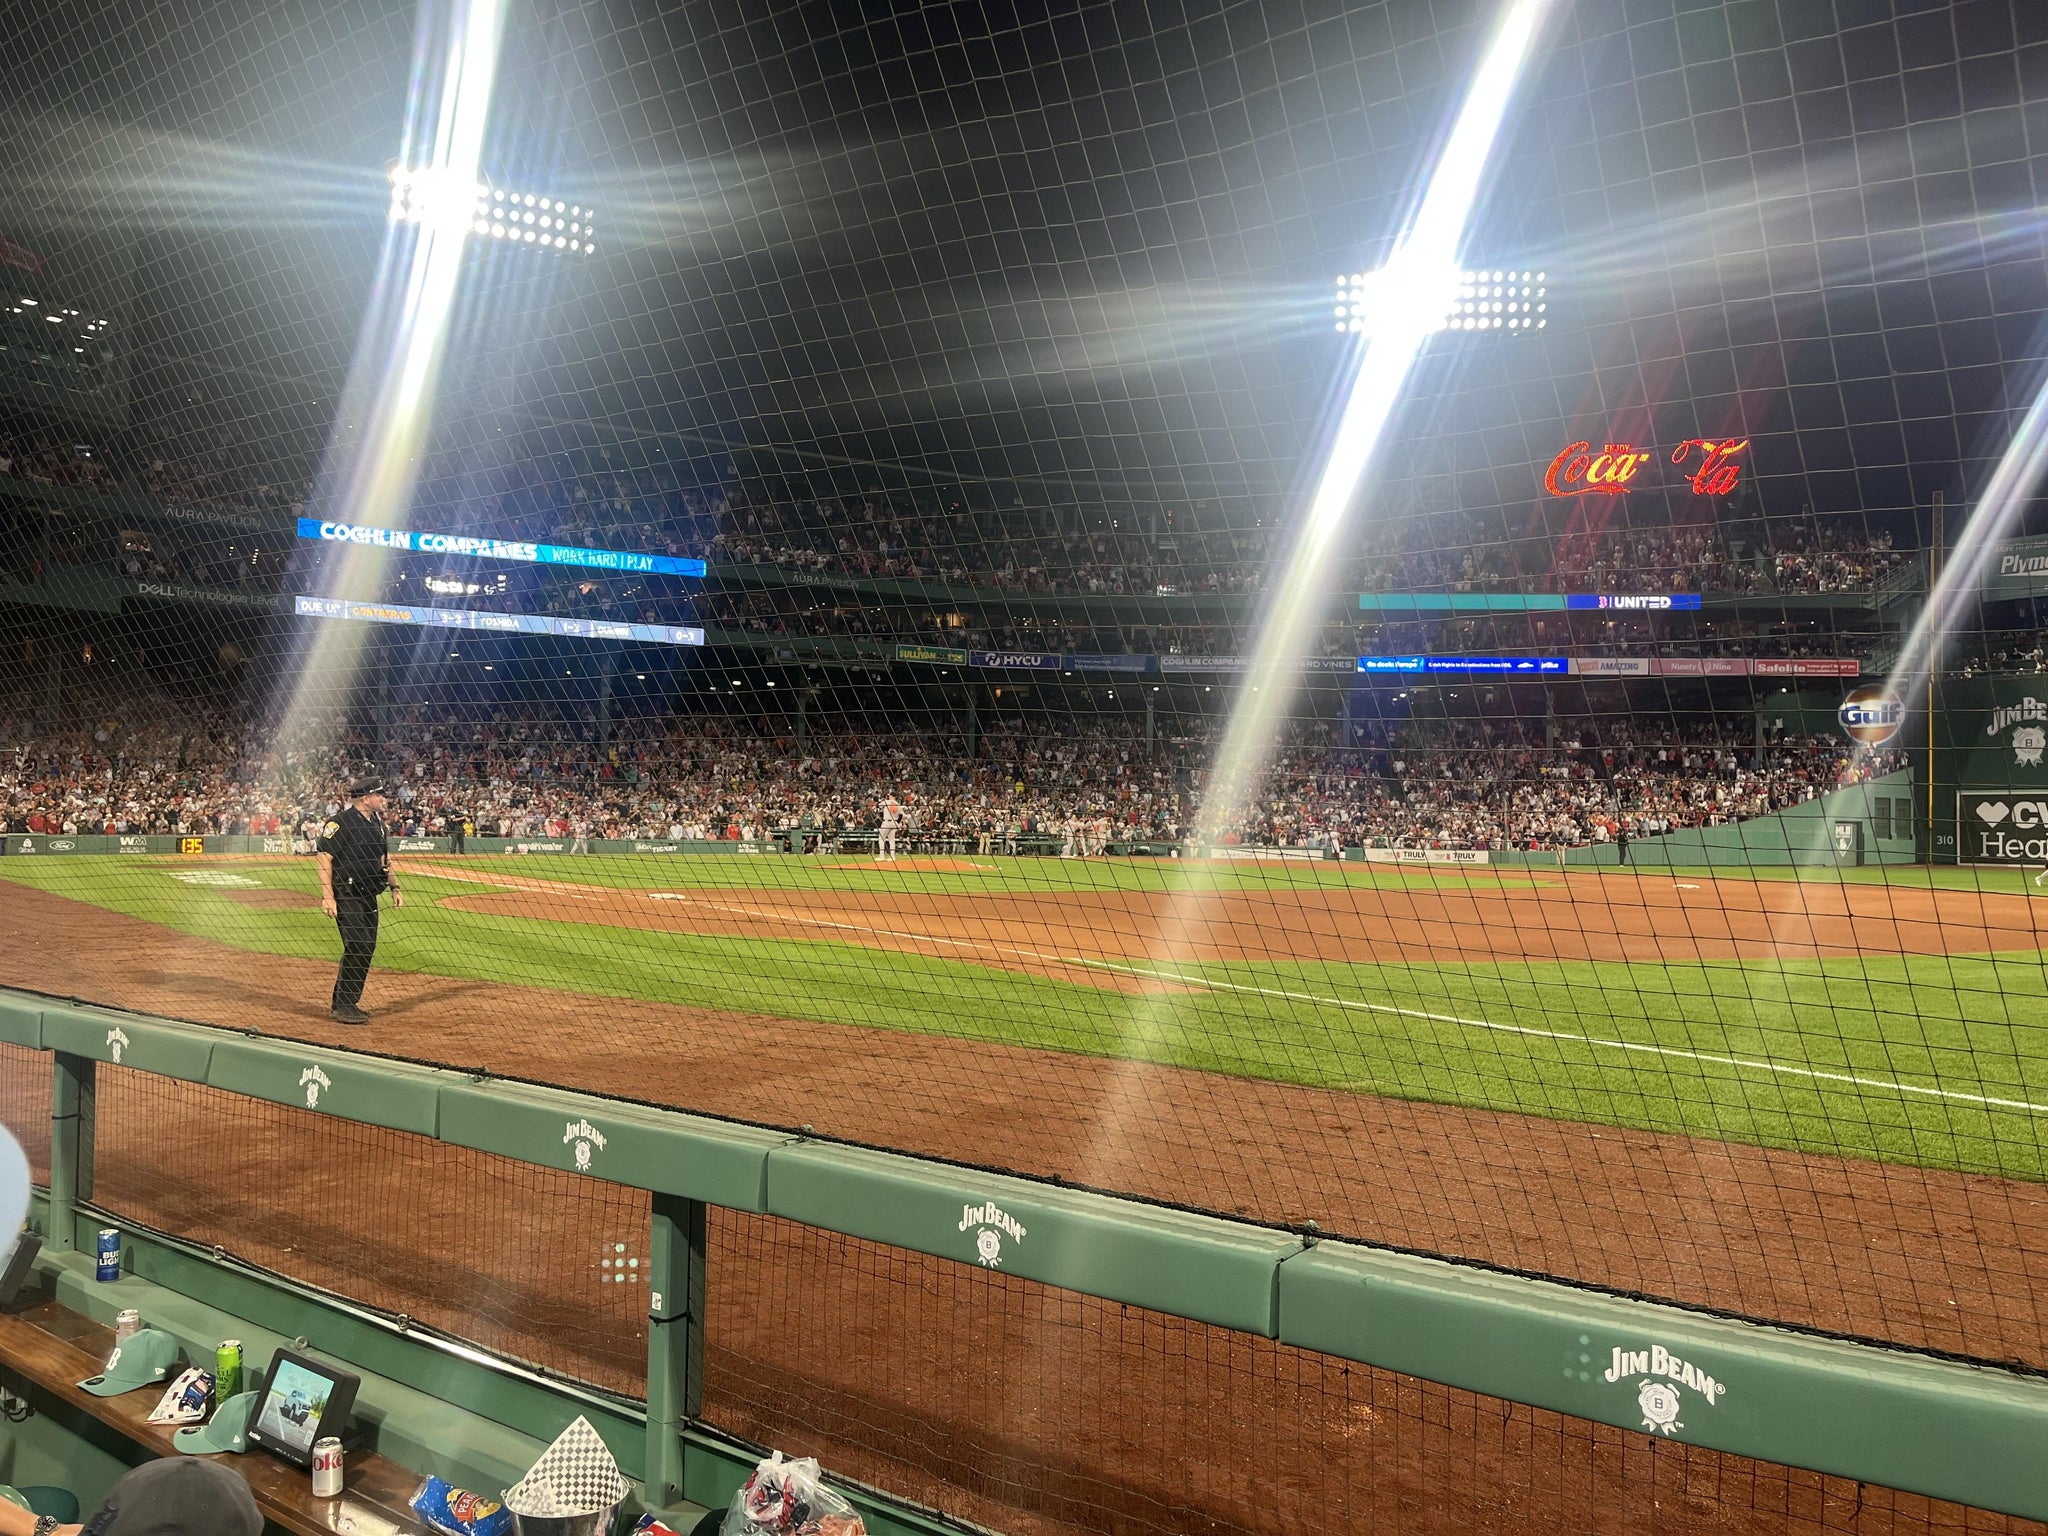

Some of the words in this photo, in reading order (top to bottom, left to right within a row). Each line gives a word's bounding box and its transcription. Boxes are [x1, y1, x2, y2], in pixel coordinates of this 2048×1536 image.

[1604, 444, 1630, 453] ENJOY
[208, 512, 260, 527] PAVILION
[320, 522, 411, 549] COGHLIN
[418, 532, 538, 561] COMPANIES
[552, 548, 585, 564] WORK
[588, 552, 617, 567] HARD
[627, 555, 653, 570] PLAY
[139, 583, 175, 597] DELL
[251, 595, 279, 606] Level
[1614, 595, 1671, 609] UNITED
[301, 600, 322, 612] DUE
[326, 603, 340, 614] UP
[353, 607, 411, 620] CONTRERAS
[481, 617, 520, 629] YOSHIDA
[899, 648, 936, 660] SULLIVAN
[1004, 655, 1041, 666] HYCU
[1162, 657, 1200, 666] COGHLIN
[1323, 661, 1352, 669] VINES
[1600, 662, 1639, 670] AMAZING
[1671, 662, 1697, 672] Ninety
[1712, 662, 1732, 670] Nine
[1758, 663, 1806, 673] Safelite
[1841, 703, 1901, 726] Gulf
[1936, 835, 1954, 846] 310
[1980, 831, 2048, 859] Hea
[652, 845, 678, 853] TICKET
[563, 1122, 580, 1144] JIM
[958, 1204, 985, 1232] JIM
[99, 1258, 120, 1266] LIGH
[1604, 1346, 1649, 1383] JIM
[313, 1452, 342, 1472] oke
